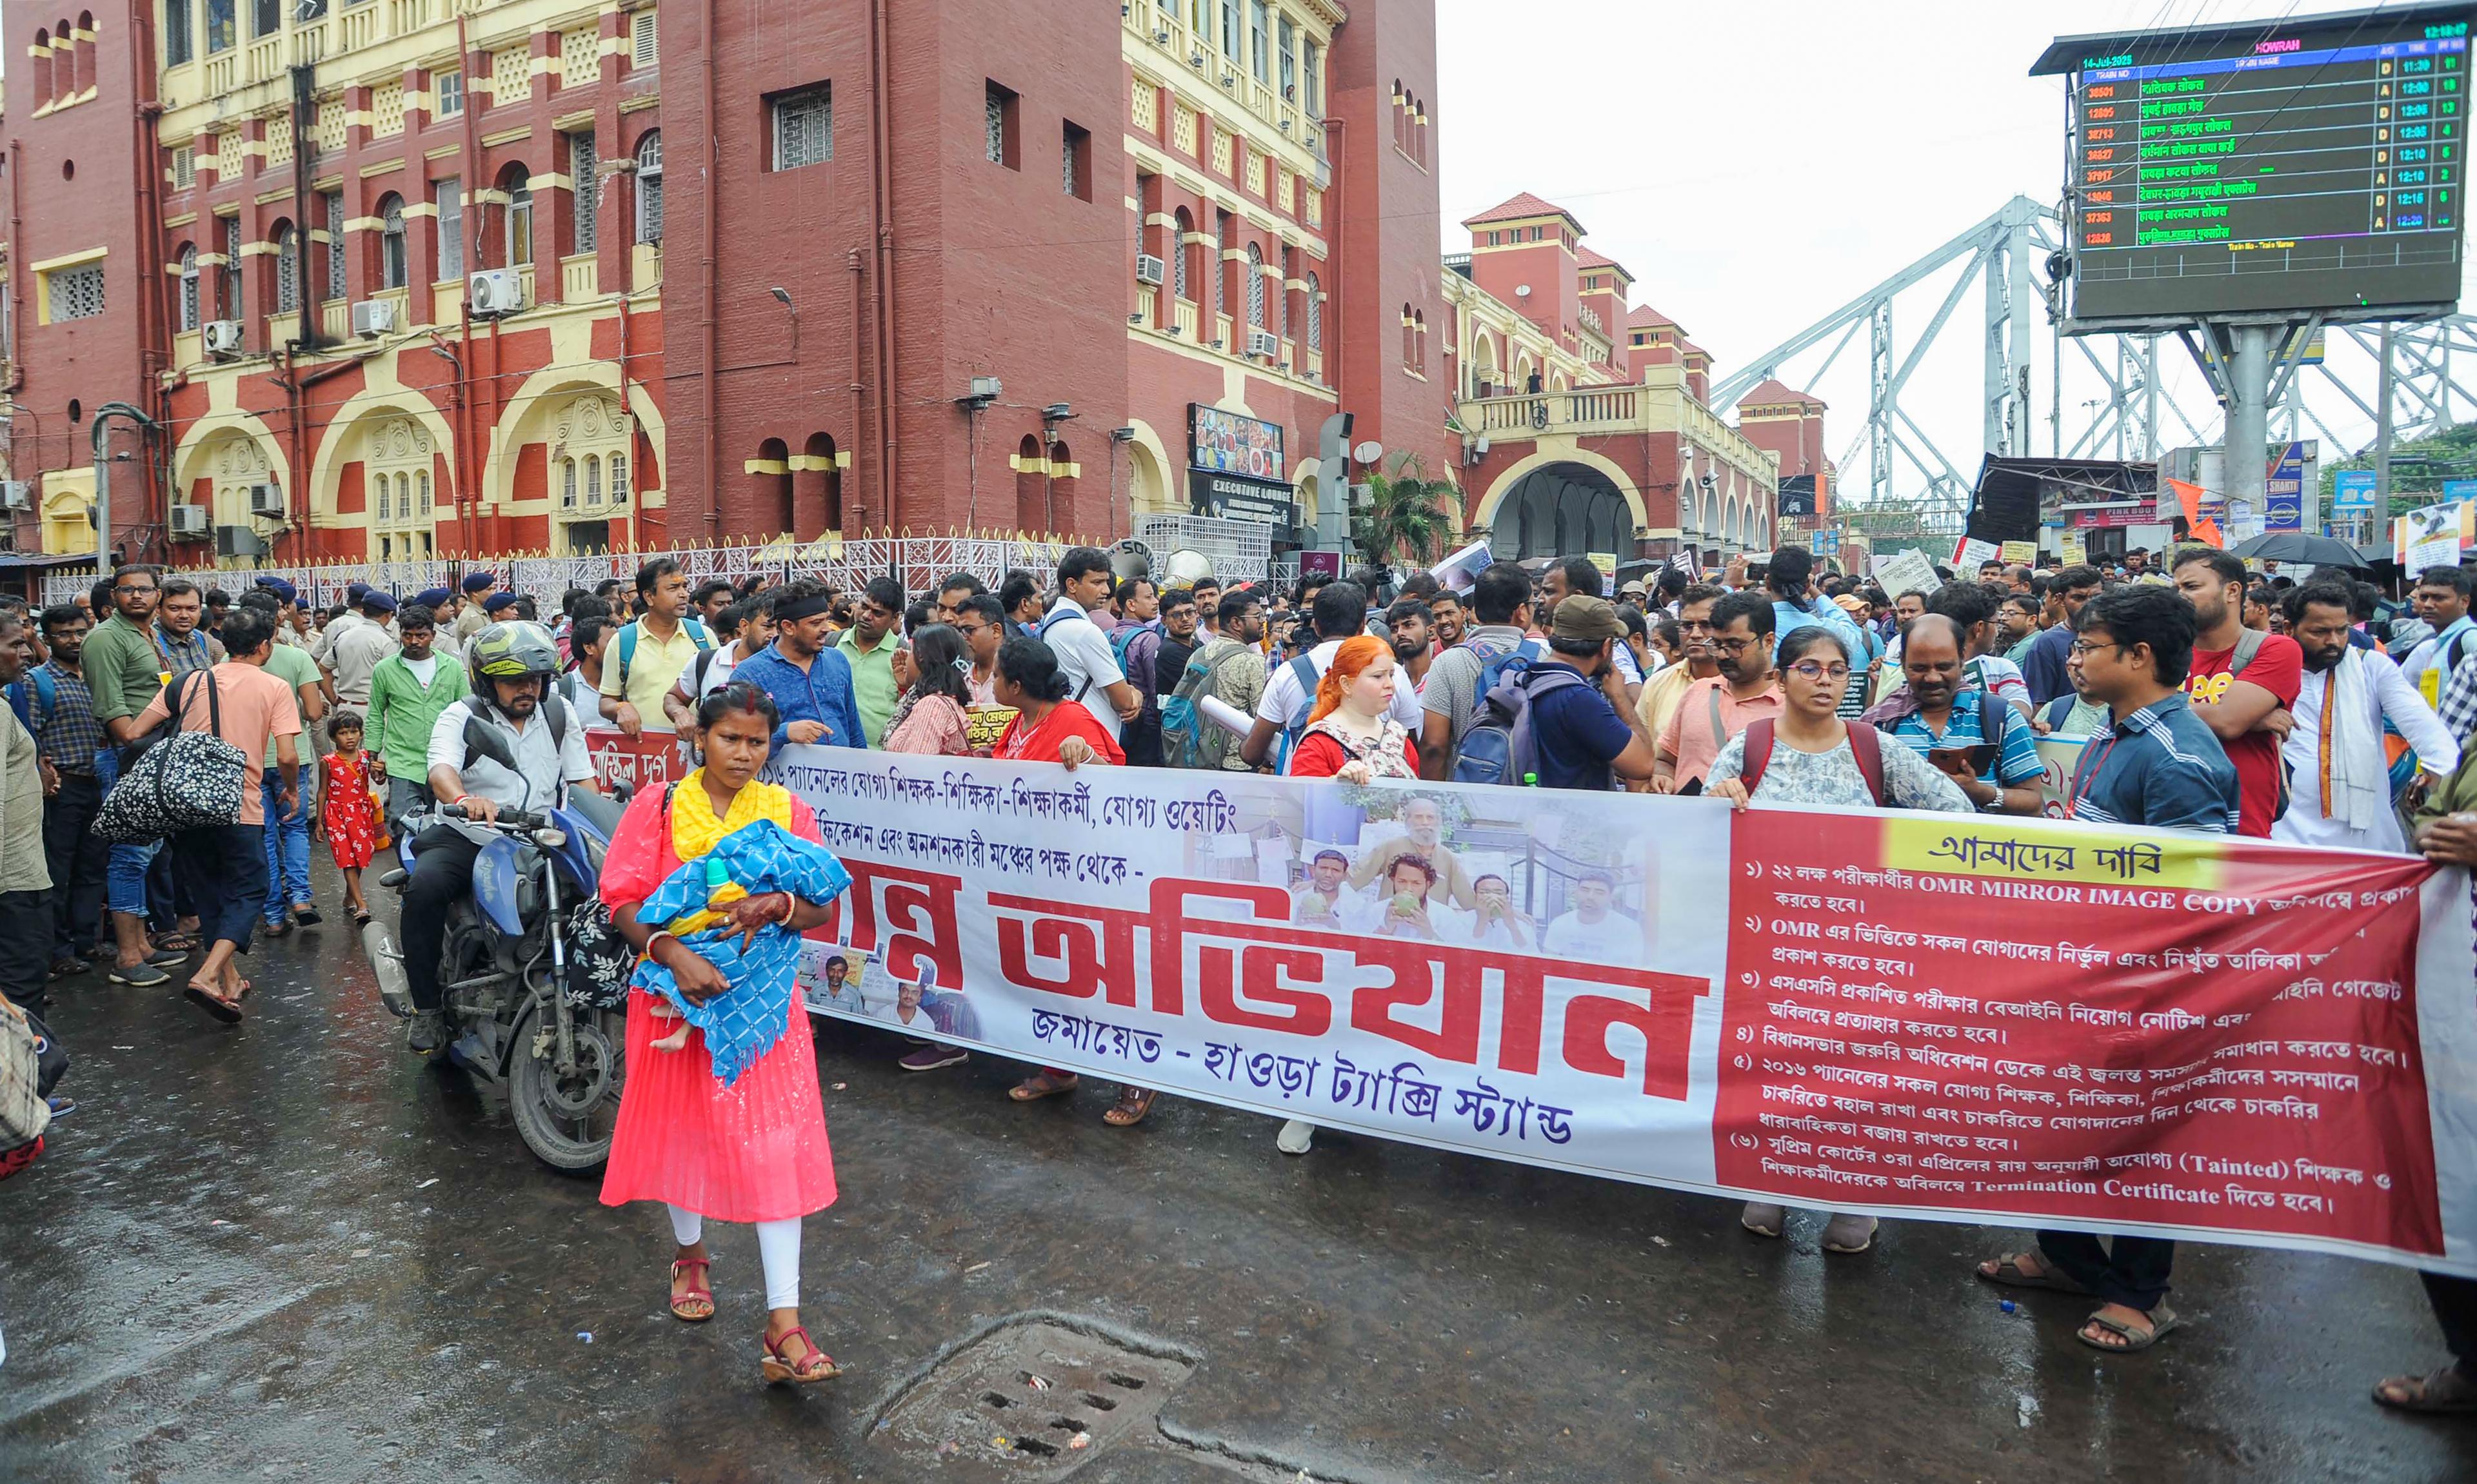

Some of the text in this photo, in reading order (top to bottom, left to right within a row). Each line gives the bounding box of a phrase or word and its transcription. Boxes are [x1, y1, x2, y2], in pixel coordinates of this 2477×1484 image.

[2255, 39, 2301, 54] HOWRAH
[2381, 62, 2391, 75] D
[2380, 84, 2390, 97] A
[2379, 107, 2389, 119] D
[2378, 124, 2452, 140] D 4
[2378, 152, 2387, 163] D
[2376, 173, 2386, 184] A
[2441, 168, 2450, 181] 2
[2376, 195, 2385, 206] D
[2375, 217, 2384, 228] A
[1212, 479, 1291, 503] EXECUTIVE LOUNGE
[2269, 480, 2297, 493] SHAKTI
[755, 762, 785, 786] ০১৬
[788, 766, 847, 795] প্যানেলের
[852, 773, 886, 800] যোগ্য
[1104, 796, 1155, 827] যোগ্য
[1164, 789, 1237, 834] ওয়েটিং
[815, 807, 873, 851] ফিকেশন
[878, 829, 902, 855] এবং
[908, 829, 984, 868] অনশনকারী
[990, 844, 1033, 875] মঞ্চের
[1039, 849, 1070, 878] পক্ষ
[1077, 853, 1126, 885] থেকে
[1927, 835, 2161, 878] আমাদের দাবি
[1746, 861, 1762, 878] ১)
[1773, 865, 1793, 880] ২২
[1795, 867, 1827, 882] লক্ষ
[1833, 866, 1912, 889] পরীক্ষার্থীর
[1919, 878, 1975, 895] OMR
[1982, 882, 2081, 902] MIRROR
[2088, 889, 2175, 909] IMAGE
[2184, 895, 2260, 915] COPY
[1774, 893, 1821, 908] করতে
[1746, 915, 1761, 933] ২)
[1771, 920, 1820, 938] OMR
[1825, 925, 1850, 940] এর
[1854, 922, 1918, 946] ভিত্তিতে
[1922, 935, 1967, 953] সকল
[1973, 940, 2051, 960] যোগ্যদের
[2056, 942, 2111, 969] নির্ভুল
[2117, 953, 2157, 967] এবং
[2163, 947, 2220, 973] নিখুঁত
[2225, 949, 2301, 970] তালিকা
[1773, 947, 1817, 965] প্রকাশ
[1821, 953, 1870, 970] করতে
[988, 878, 1710, 1102] অভিযান
[1741, 970, 1760, 988] ৩)
[1769, 976, 1836, 996] এসএসসি
[1842, 982, 1908, 1004] প্রকাশিত
[1913, 989, 1978, 1013] পরীক্ষার
[1985, 1000, 2062, 1020] বেআইনি
[2067, 1003, 2131, 1026] নিয়োগ
[2140, 1008, 2205, 1031] নোটিশ
[2333, 980, 2400, 1000] গেজেট
[1767, 1000, 1831, 1025] অবিলম্বে
[1835, 1012, 1899, 1033] প্রত্যাহার
[1904, 1021, 1957, 1038] করতে
[1736, 1025, 1753, 1043] ৪)
[1762, 1025, 1845, 1054] বিধানসভার
[1849, 1041, 1900, 1060] জরুরি
[1905, 1045, 1988, 1072] অধিবেশন
[1995, 1060, 2045, 1077] ডেকে
[2053, 1063, 2084, 1082] এই
[2087, 1069, 2142, 1083] জ্বলন্ত
[2214, 1040, 2278, 1058] সমাধান
[2284, 1041, 2350, 1058] করতে
[1032, 1009, 1162, 1062] জমায়েত
[1205, 1042, 1320, 1098] হাওড়া
[1332, 1051, 1442, 1122] ট্যাক্সি
[1455, 1076, 1572, 1144] স্ট্যান্ড
[1763, 1058, 1806, 1076] ২০১৬
[1813, 1064, 1889, 1088] প্যানেলের
[1893, 1076, 1937, 1095] সকল
[1944, 1083, 1991, 1100] যোগ্য
[1995, 1083, 2061, 1107] শিক্ষক,
[2067, 1089, 2144, 1107] শিক্ষিকা,
[2152, 1068, 2263, 1101] শিক্ষাকর্মীদের
[2270, 1071, 2358, 1092] সসম্মানে
[1762, 1084, 2318, 1129] চাকরিতে বহাল রাখা এবং চাকরিতে যোগদানের দিন থেকে চাকরির
[1760, 1113, 1856, 1136] ধারাবাহিকতা
[1861, 1125, 1907, 1143] বজায়
[1911, 1132, 1968, 1147] রাখতে
[1731, 1133, 2391, 1189] (৬) সুপ্রিম কোর্টের ৩রা এপ্রিলের রায় অনুযায়ী অযোগ্য (Tainted) শিক্ষক ও
[1760, 1157, 1887, 1187] শিক্ষাকর্মীদেরকে
[1893, 1175, 1964, 1192] অবিলম্বে
[1971, 1180, 2096, 1194] Termination
[2104, 1180, 2220, 1204] Certificate
[2224, 1183, 2274, 1207] দিতে
